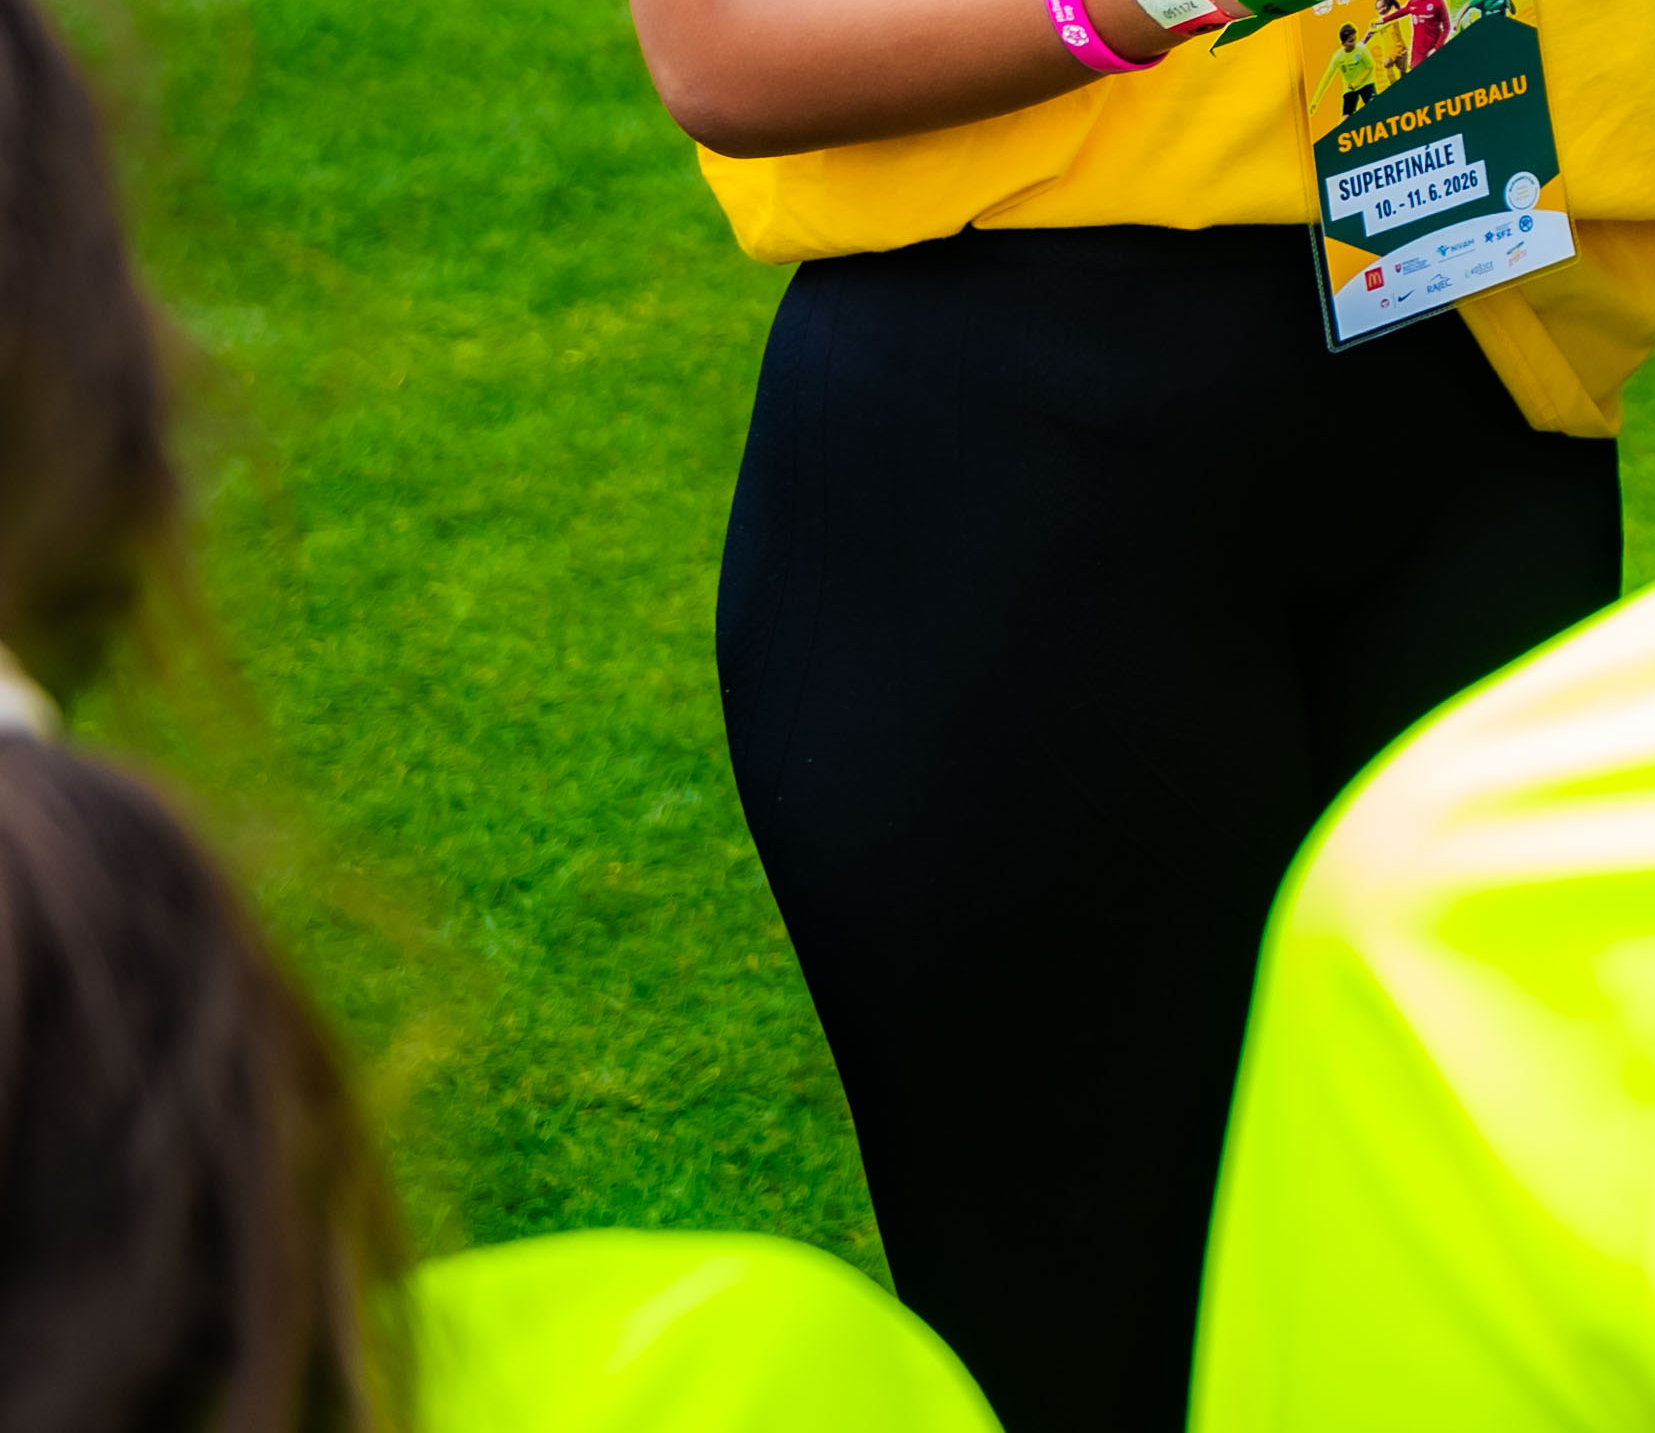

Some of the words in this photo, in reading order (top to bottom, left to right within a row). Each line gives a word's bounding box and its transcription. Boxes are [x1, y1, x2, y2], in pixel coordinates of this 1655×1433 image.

[1337, 105, 1432, 153] SVIATOK
[1434, 75, 1528, 122] FUTBALU
[1338, 143, 1455, 201] SUPERFINÁLE
[1375, 199, 1397, 220] 10.
[1407, 188, 1427, 207] 11.
[1429, 183, 1442, 202] 6.
[1443, 169, 1479, 197] 2026
[1426, 278, 1453, 294] RAJEC
